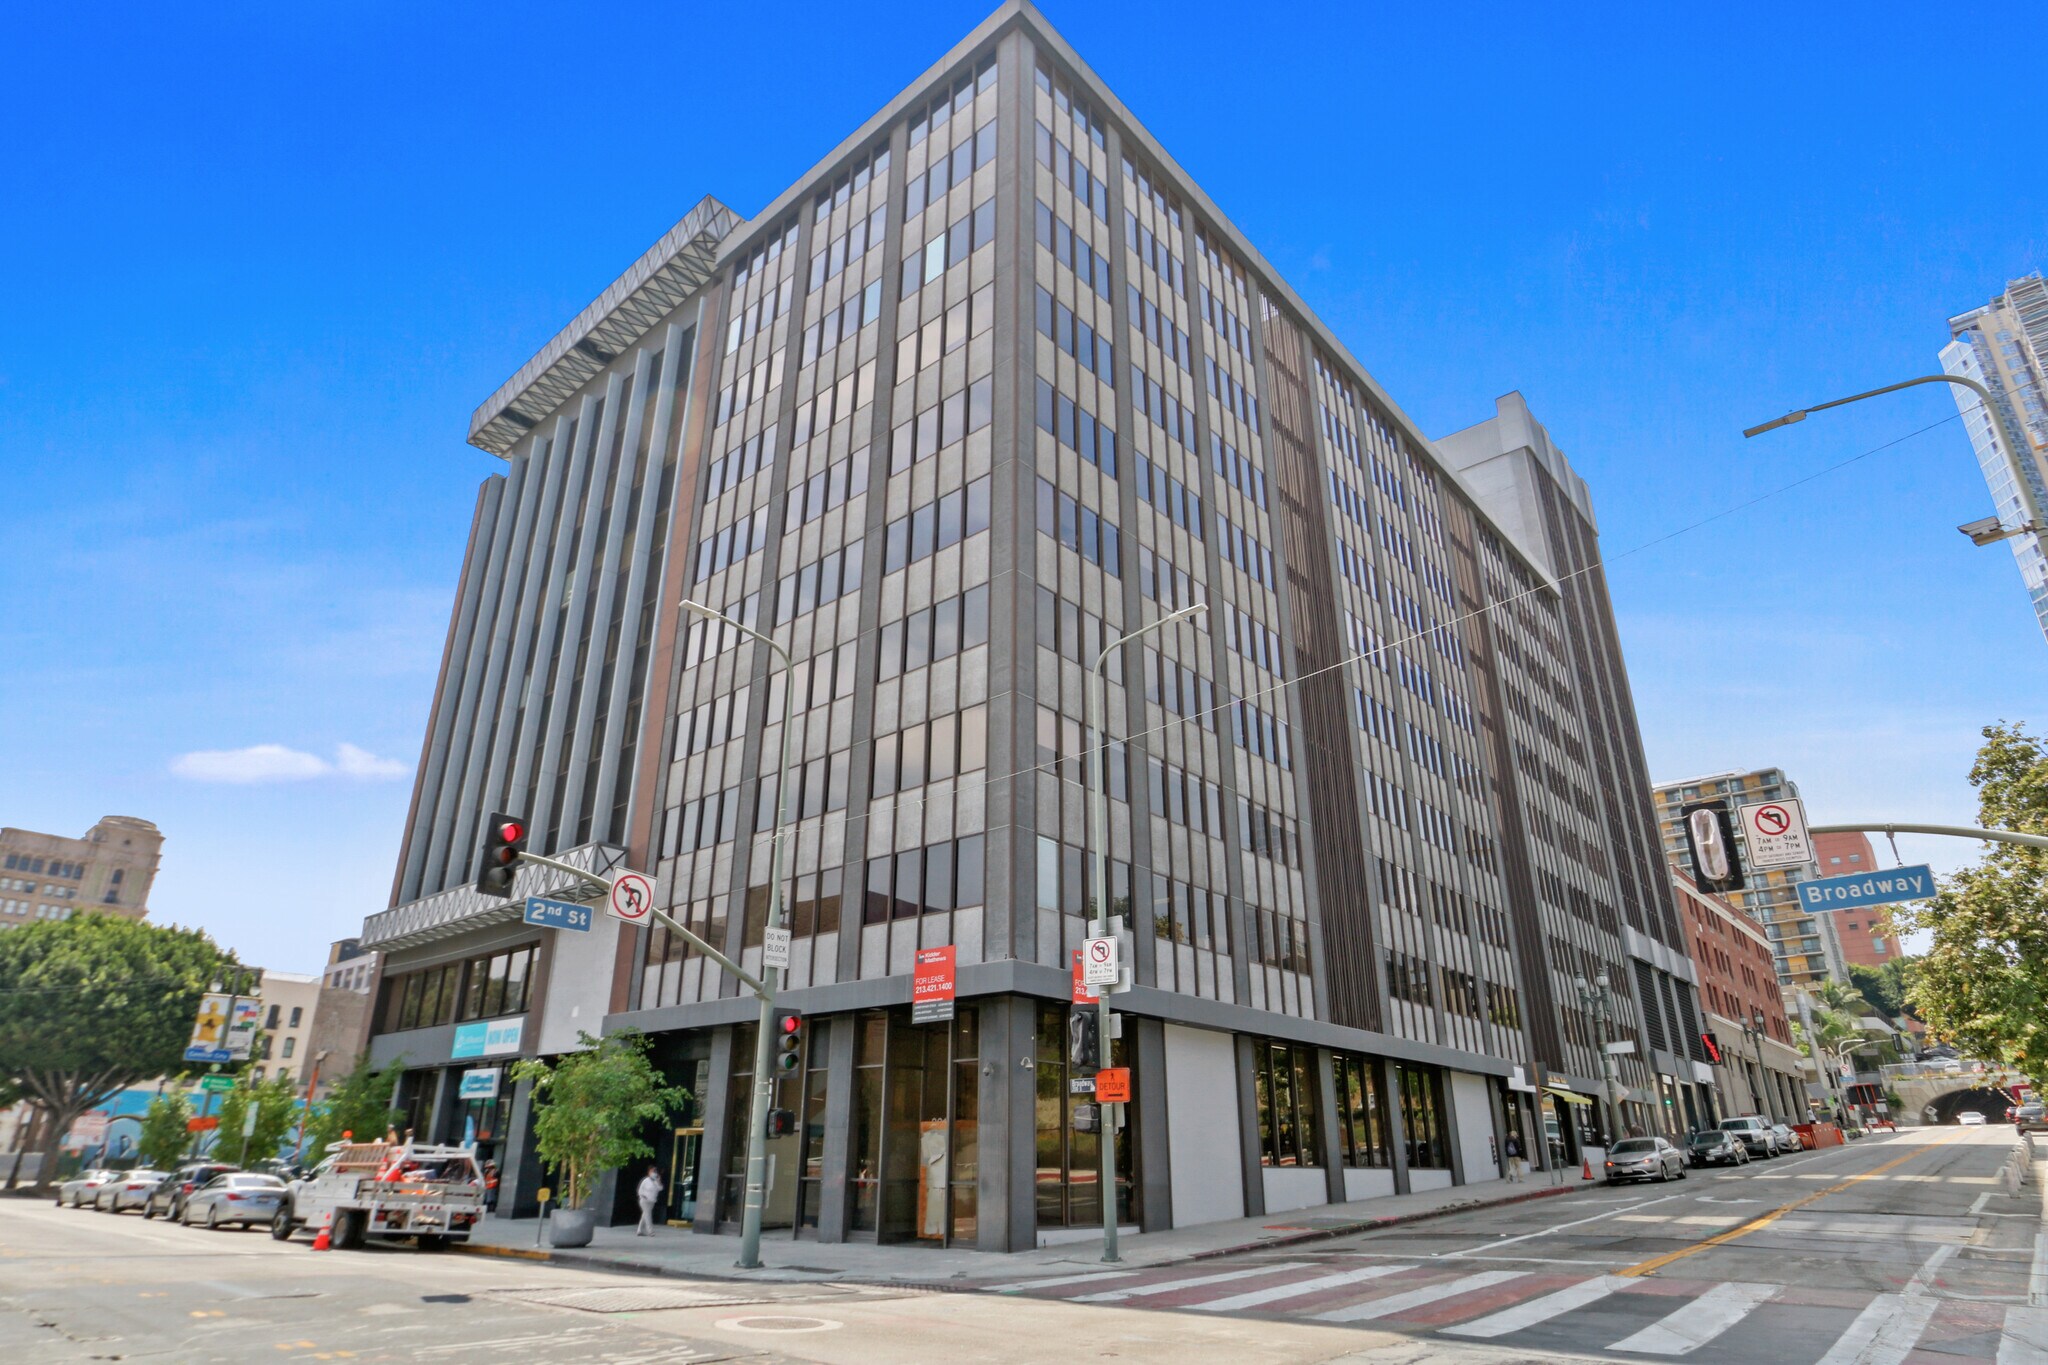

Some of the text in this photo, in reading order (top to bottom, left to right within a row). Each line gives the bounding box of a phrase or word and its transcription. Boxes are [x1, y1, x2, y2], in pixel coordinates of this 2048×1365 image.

[1806, 875, 1922, 903] Broadway
[531, 902, 587, 926] 2nd St
[777, 934, 789, 942] NOT
[767, 944, 787, 953] BLOCK
[916, 974, 945, 985] FOR LEASE
[915, 982, 952, 994] 213.421.1400
[1099, 1081, 1125, 1091] DETOUR
